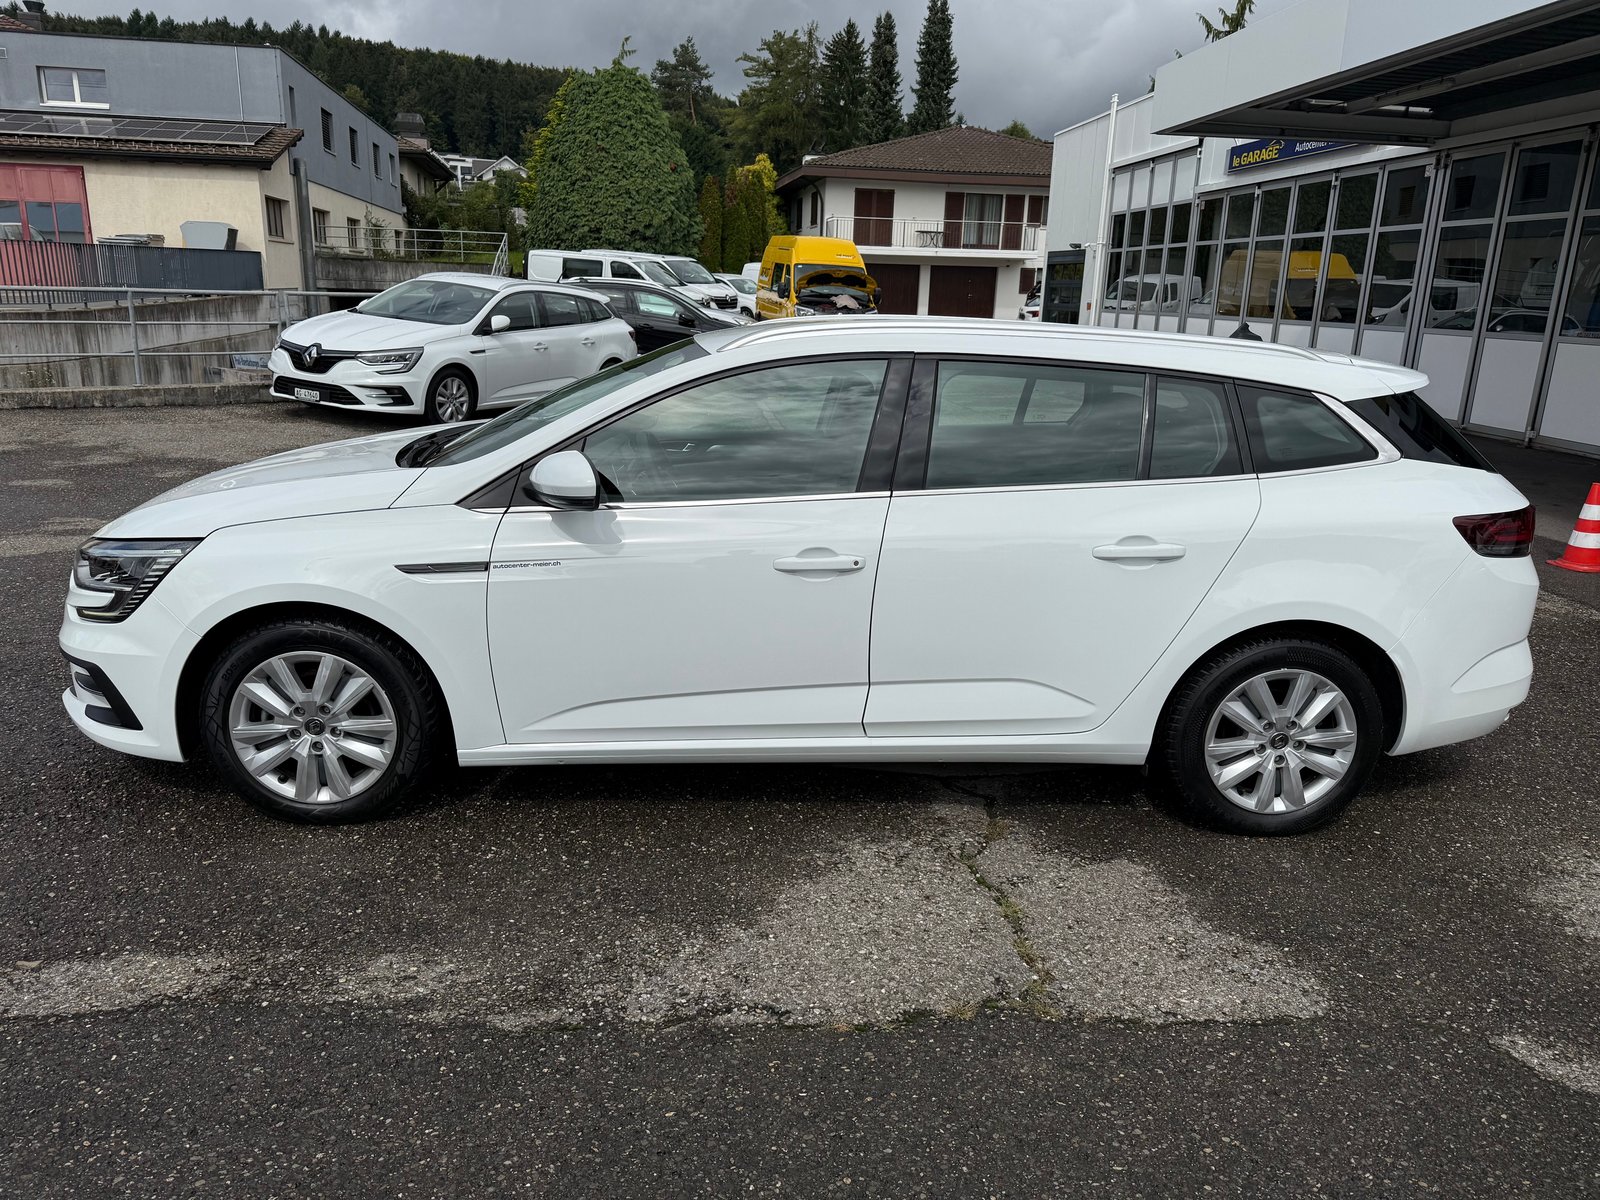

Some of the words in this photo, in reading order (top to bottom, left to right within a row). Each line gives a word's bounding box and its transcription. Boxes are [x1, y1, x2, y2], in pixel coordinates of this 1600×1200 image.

[1232, 155, 1240, 166] le
[1241, 145, 1280, 164] GARAGE
[492, 560, 562, 569] autocenter-meier.ch
